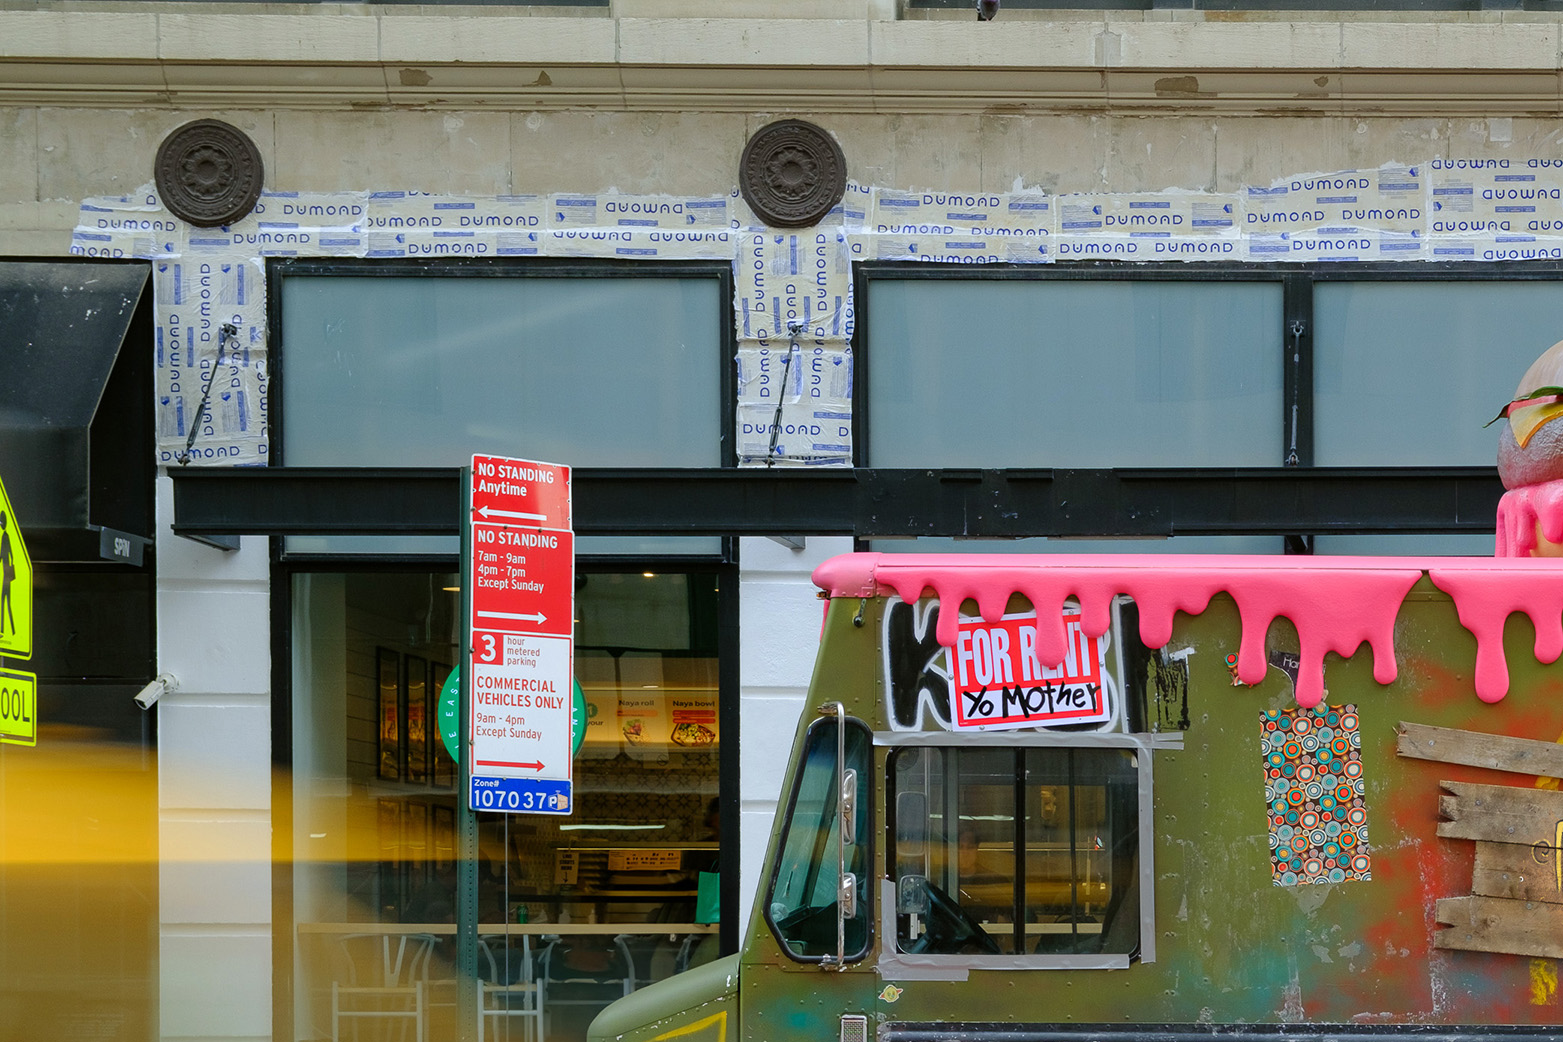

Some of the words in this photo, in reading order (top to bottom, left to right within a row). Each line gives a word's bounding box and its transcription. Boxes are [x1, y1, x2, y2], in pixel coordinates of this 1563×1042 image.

[478, 463, 495, 477] NO
[498, 465, 554, 484] STANDING
[478, 479, 528, 497] Anytime
[478, 530, 495, 544] NO
[498, 532, 558, 549] STANDING
[478, 550, 498, 562] 7am
[506, 553, 526, 565] 9am
[478, 564, 498, 576] 4pm
[506, 566, 526, 579] 7pm
[478, 577, 509, 591] Except
[511, 579, 544, 594] Sunday
[480, 634, 496, 662] 3
[507, 636, 525, 647] hour
[507, 647, 541, 657] metered
[957, 628, 1014, 687] FOR
[1018, 620, 1093, 682] RNT
[507, 657, 537, 668] parking
[477, 676, 556, 693] COMMERCIAL
[1, 687, 31, 723] OOL
[477, 692, 531, 708] VEHICLES
[535, 696, 564, 710] ONLY
[963, 685, 995, 718] Yo
[477, 713, 496, 724] 9am
[505, 714, 525, 726] 4pm
[476, 726, 507, 738] Except
[509, 728, 543, 742] Sunday
[474, 778, 500, 788] Zone#
